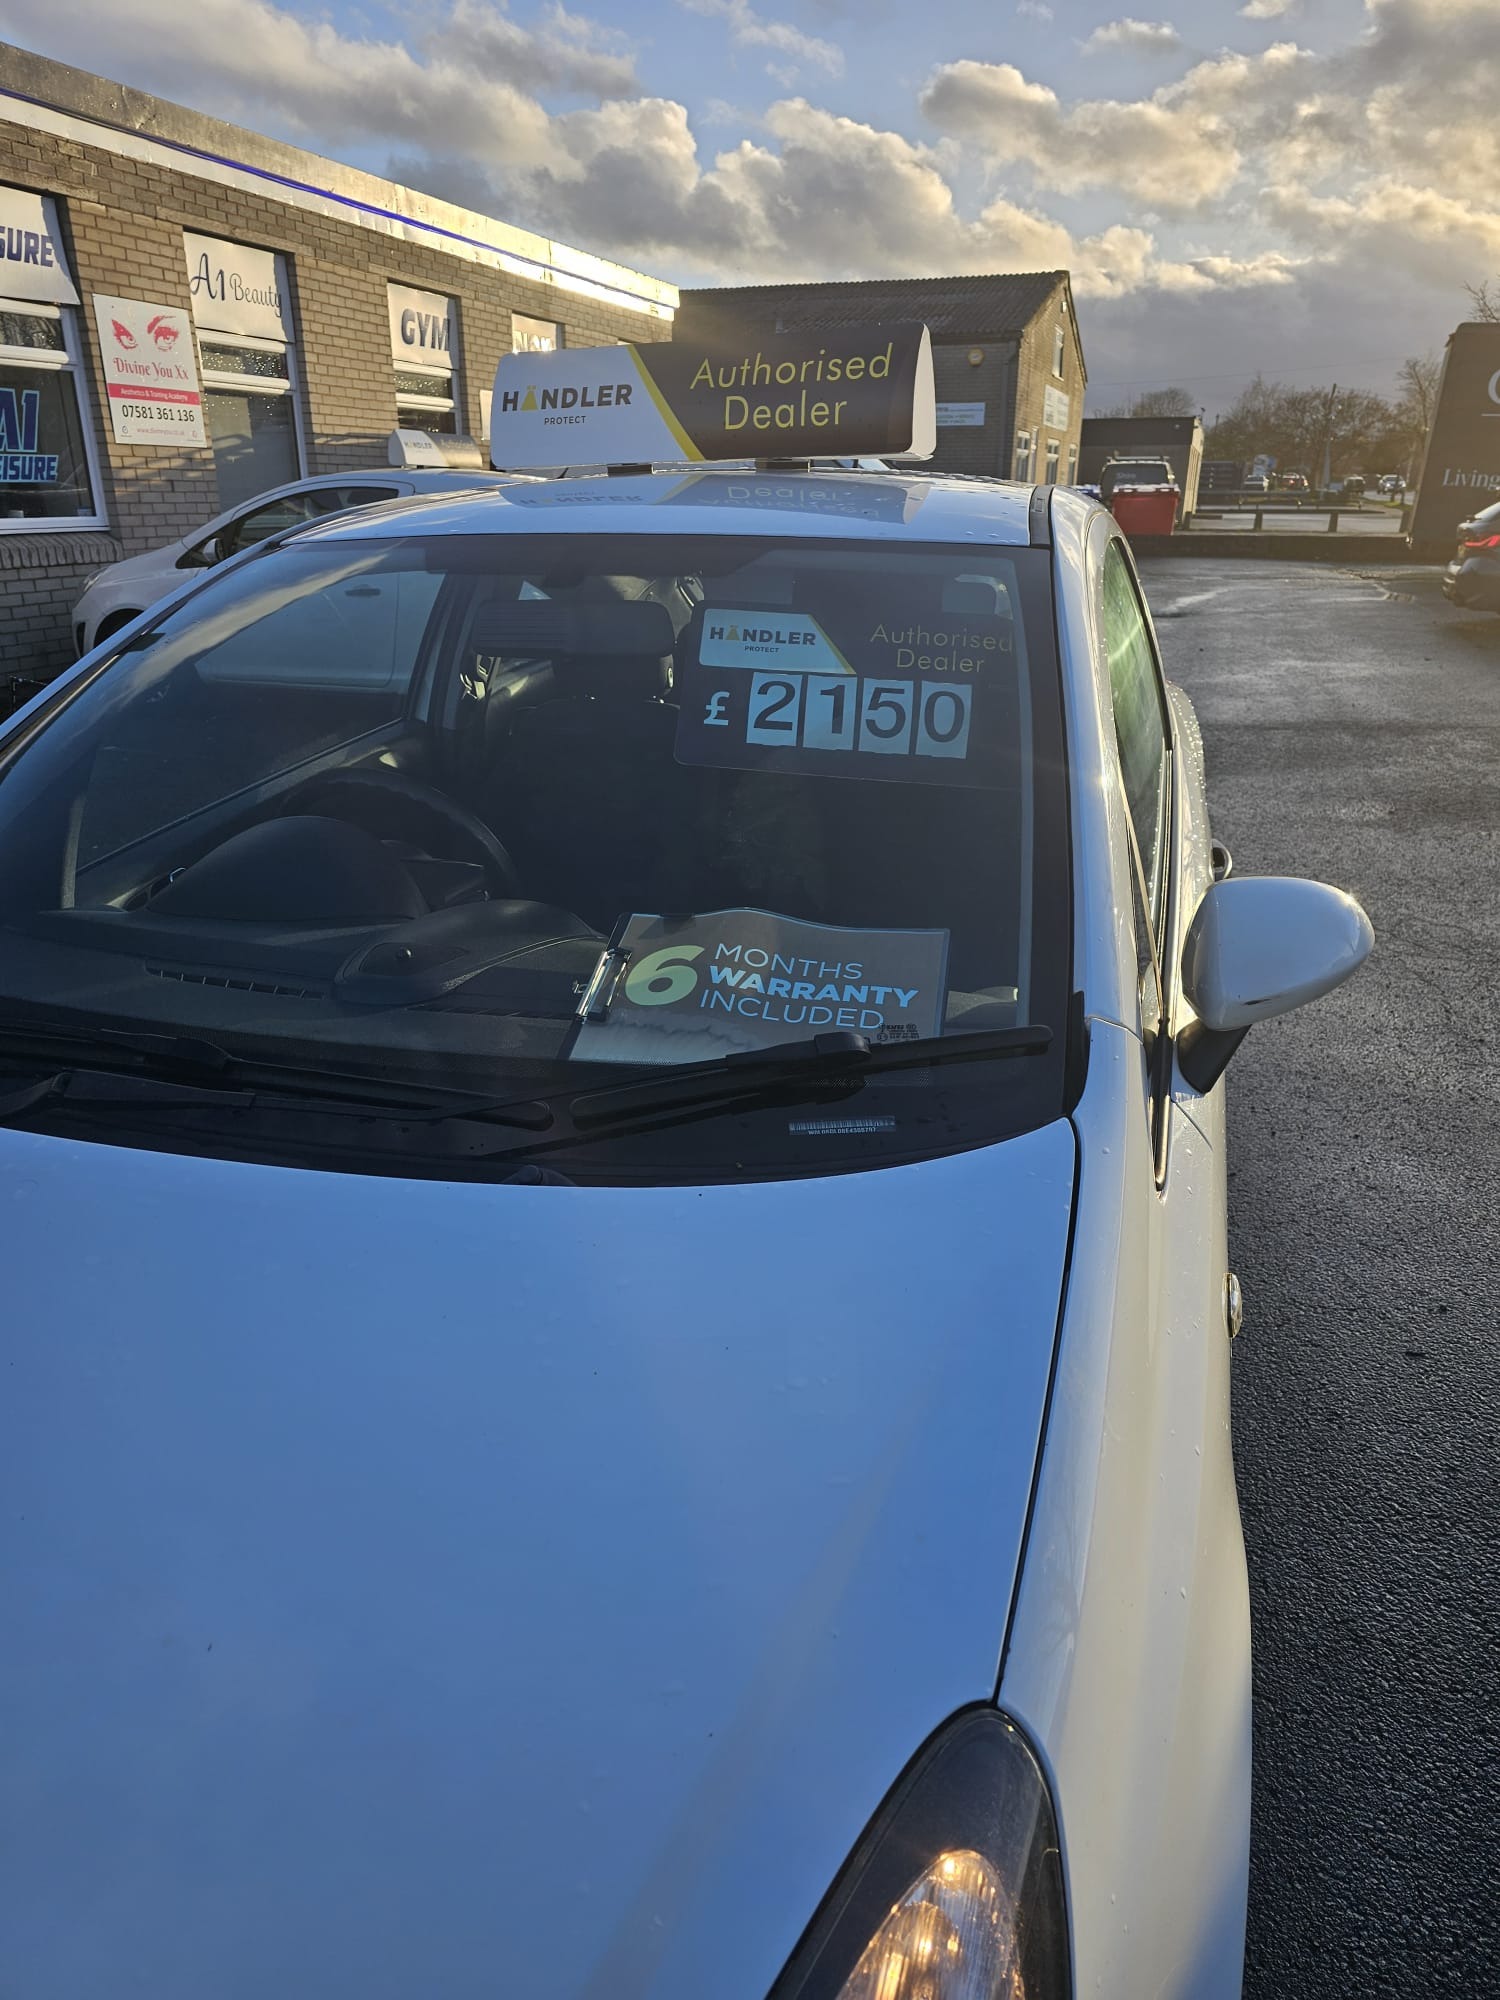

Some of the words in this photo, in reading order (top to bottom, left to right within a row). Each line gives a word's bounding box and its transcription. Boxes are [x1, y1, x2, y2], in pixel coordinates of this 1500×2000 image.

[229, 272, 282, 318] Beauty
[401, 308, 451, 352] GYM
[113, 357, 151, 376] Divine
[151, 361, 173, 381] You
[689, 341, 893, 390] Authorised
[121, 404, 154, 420] 07581
[156, 407, 175, 420] 361
[177, 409, 195, 422] 136
[543, 415, 587, 425] PROTECT
[724, 389, 848, 431] Dealer
[0, 453, 59, 483] ISURE
[1442, 468, 1500, 490] Living
[744, 645, 779, 653] PROTECT
[869, 623, 1013, 654] Authorised
[896, 648, 985, 674] Dealer
[753, 680, 965, 744] 2150
[625, 944, 706, 1007] 6
[714, 942, 865, 981] MONTHS
[709, 965, 919, 1009] WARRANTY
[700, 988, 885, 1030] INCLUDED
